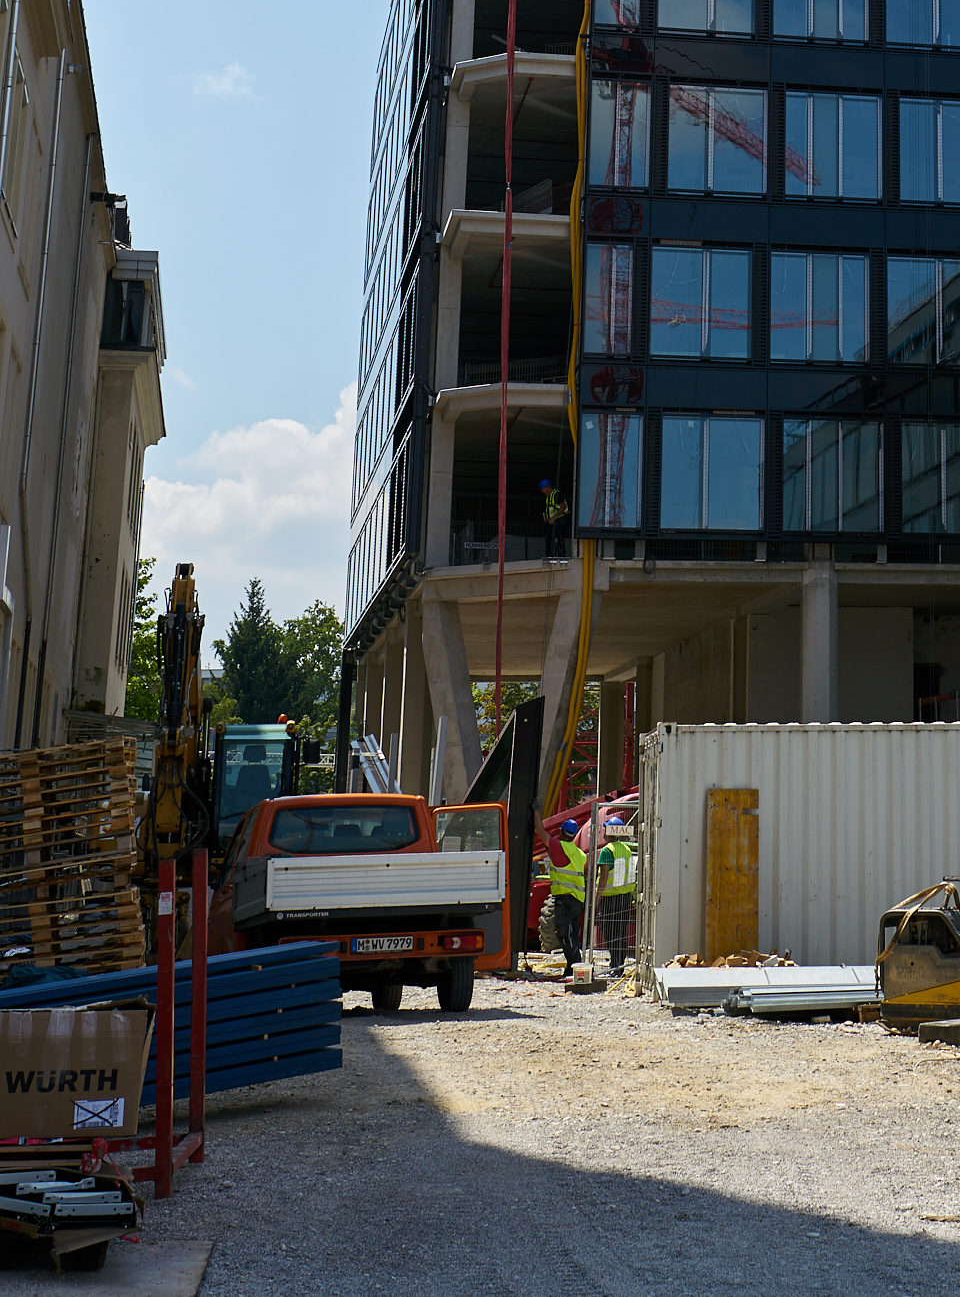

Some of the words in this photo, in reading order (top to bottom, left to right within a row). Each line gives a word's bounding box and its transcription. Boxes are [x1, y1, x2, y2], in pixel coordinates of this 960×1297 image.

[610, 826, 632, 834] MAC
[357, 940, 365, 951] M
[371, 939, 385, 950] WV
[386, 937, 412, 949] 7979
[5, 1068, 119, 1094] WÜRTH
